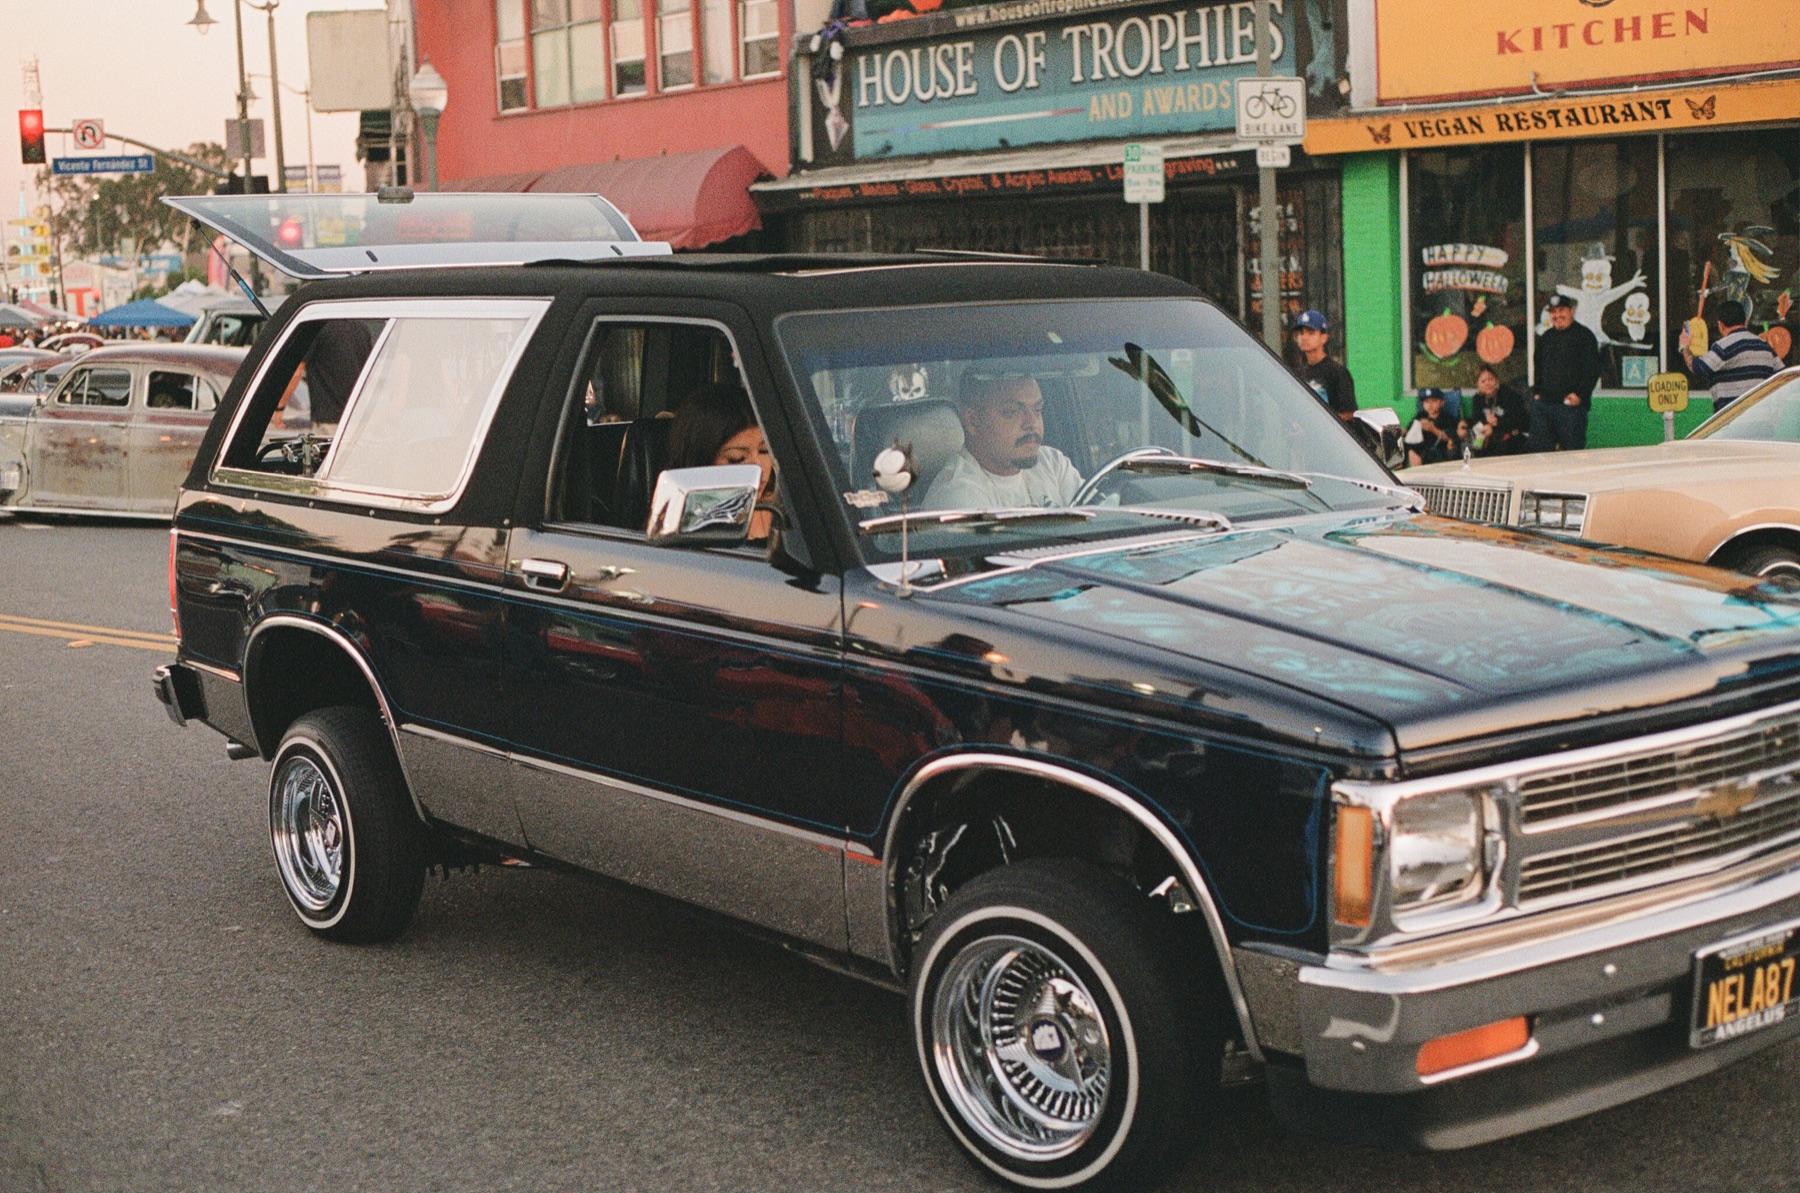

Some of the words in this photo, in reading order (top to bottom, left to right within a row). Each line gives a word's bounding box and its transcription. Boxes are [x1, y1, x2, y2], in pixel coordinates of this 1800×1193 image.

[1496, 8, 1709, 55] KITCHEN
[857, 41, 978, 107] HOUSE
[994, 31, 1047, 91] OF
[1088, 91, 1132, 121] AND
[1143, 80, 1231, 116] AWARDS
[1245, 123, 1267, 135] BIKE
[1271, 123, 1297, 134] LANE
[1404, 114, 1485, 139] VEGAN
[1496, 100, 1671, 133] RESTAURANT
[138, 157, 149, 170] St
[1005, 169, 1047, 191] Acrylic
[1048, 166, 1095, 185] Awards
[1427, 244, 1486, 262] HAPPY
[1630, 363, 1642, 380] A
[1650, 380, 1687, 393] LOADING
[1657, 393, 1679, 405] ONLY
[1706, 957, 1796, 1029] NELA87
[1714, 1004, 1786, 1040] ANGELUS
